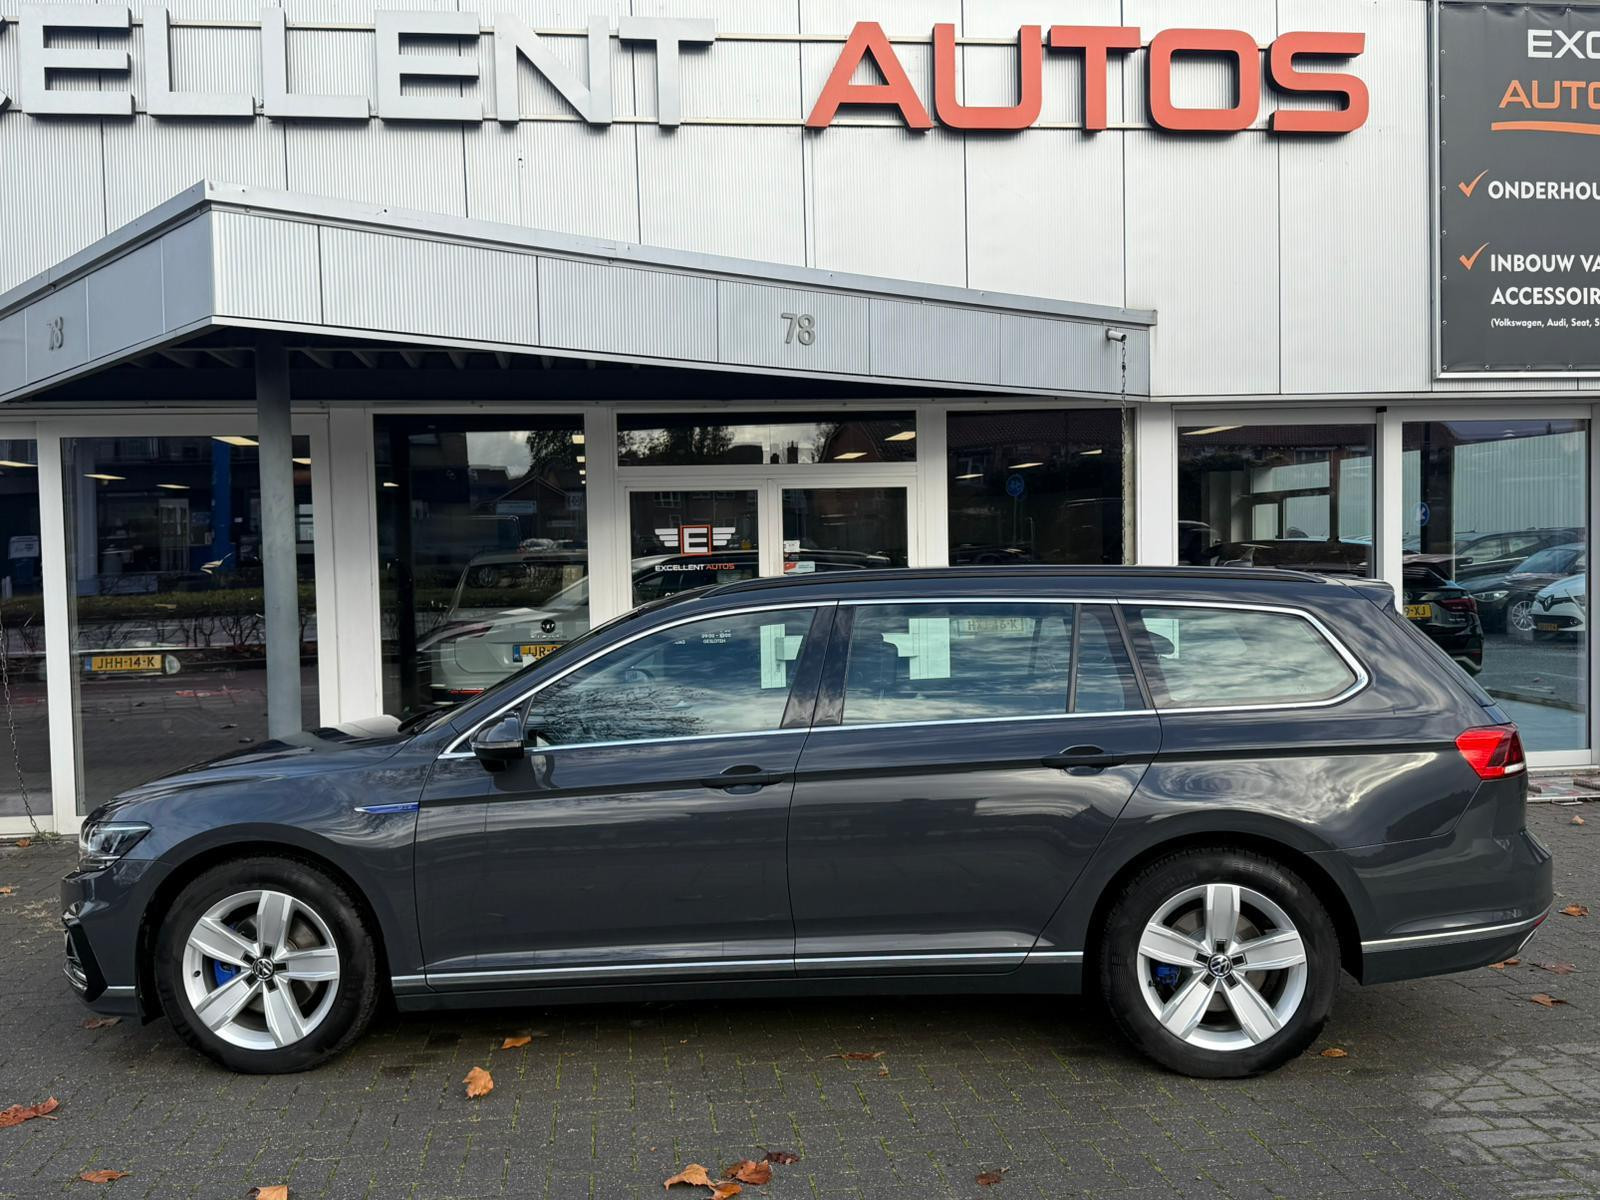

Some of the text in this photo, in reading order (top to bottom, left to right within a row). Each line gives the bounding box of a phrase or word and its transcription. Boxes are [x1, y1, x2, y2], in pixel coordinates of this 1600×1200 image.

[0, 4, 1370, 134] ELLENT AUTOS
[1490, 253, 1576, 273] INBOUW
[1490, 286, 1600, 306] ACCESSOIR
[781, 312, 816, 346] 78
[1490, 317, 1545, 329] (Volkswagen,
[1547, 317, 1569, 329] Audi,
[1571, 317, 1593, 329] Seat,
[654, 563, 736, 572] EXCELLENT AUTOS
[96, 656, 155, 669] JHH-14-K
